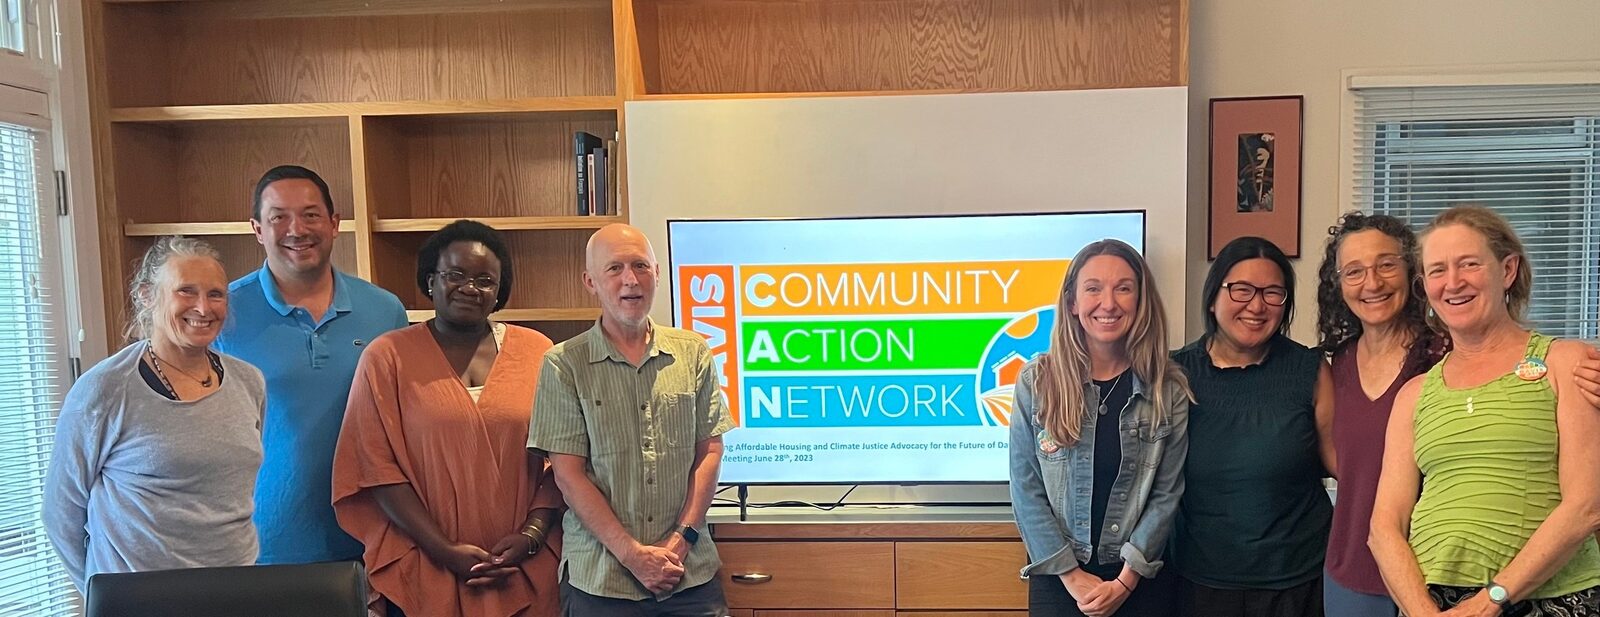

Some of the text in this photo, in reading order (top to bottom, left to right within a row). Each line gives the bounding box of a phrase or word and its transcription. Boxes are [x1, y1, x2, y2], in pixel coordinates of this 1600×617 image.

[745, 269, 1020, 308] COMMUNITY
[746, 328, 915, 363] ACTION
[750, 384, 965, 419] NETWORK
[736, 443, 777, 451] Affordable
[780, 443, 812, 452] Housing
[830, 442, 860, 450] Climate
[862, 442, 889, 450] Justice
[890, 442, 928, 451] Advocacy
[930, 441, 942, 449] for
[944, 441, 957, 449] the
[959, 441, 986, 449] Future
[988, 441, 996, 449] of
[998, 441, 1009, 449] Da
[754, 455, 773, 463] June
[774, 454, 793, 463] 28th,
[795, 454, 814, 462] 2023
